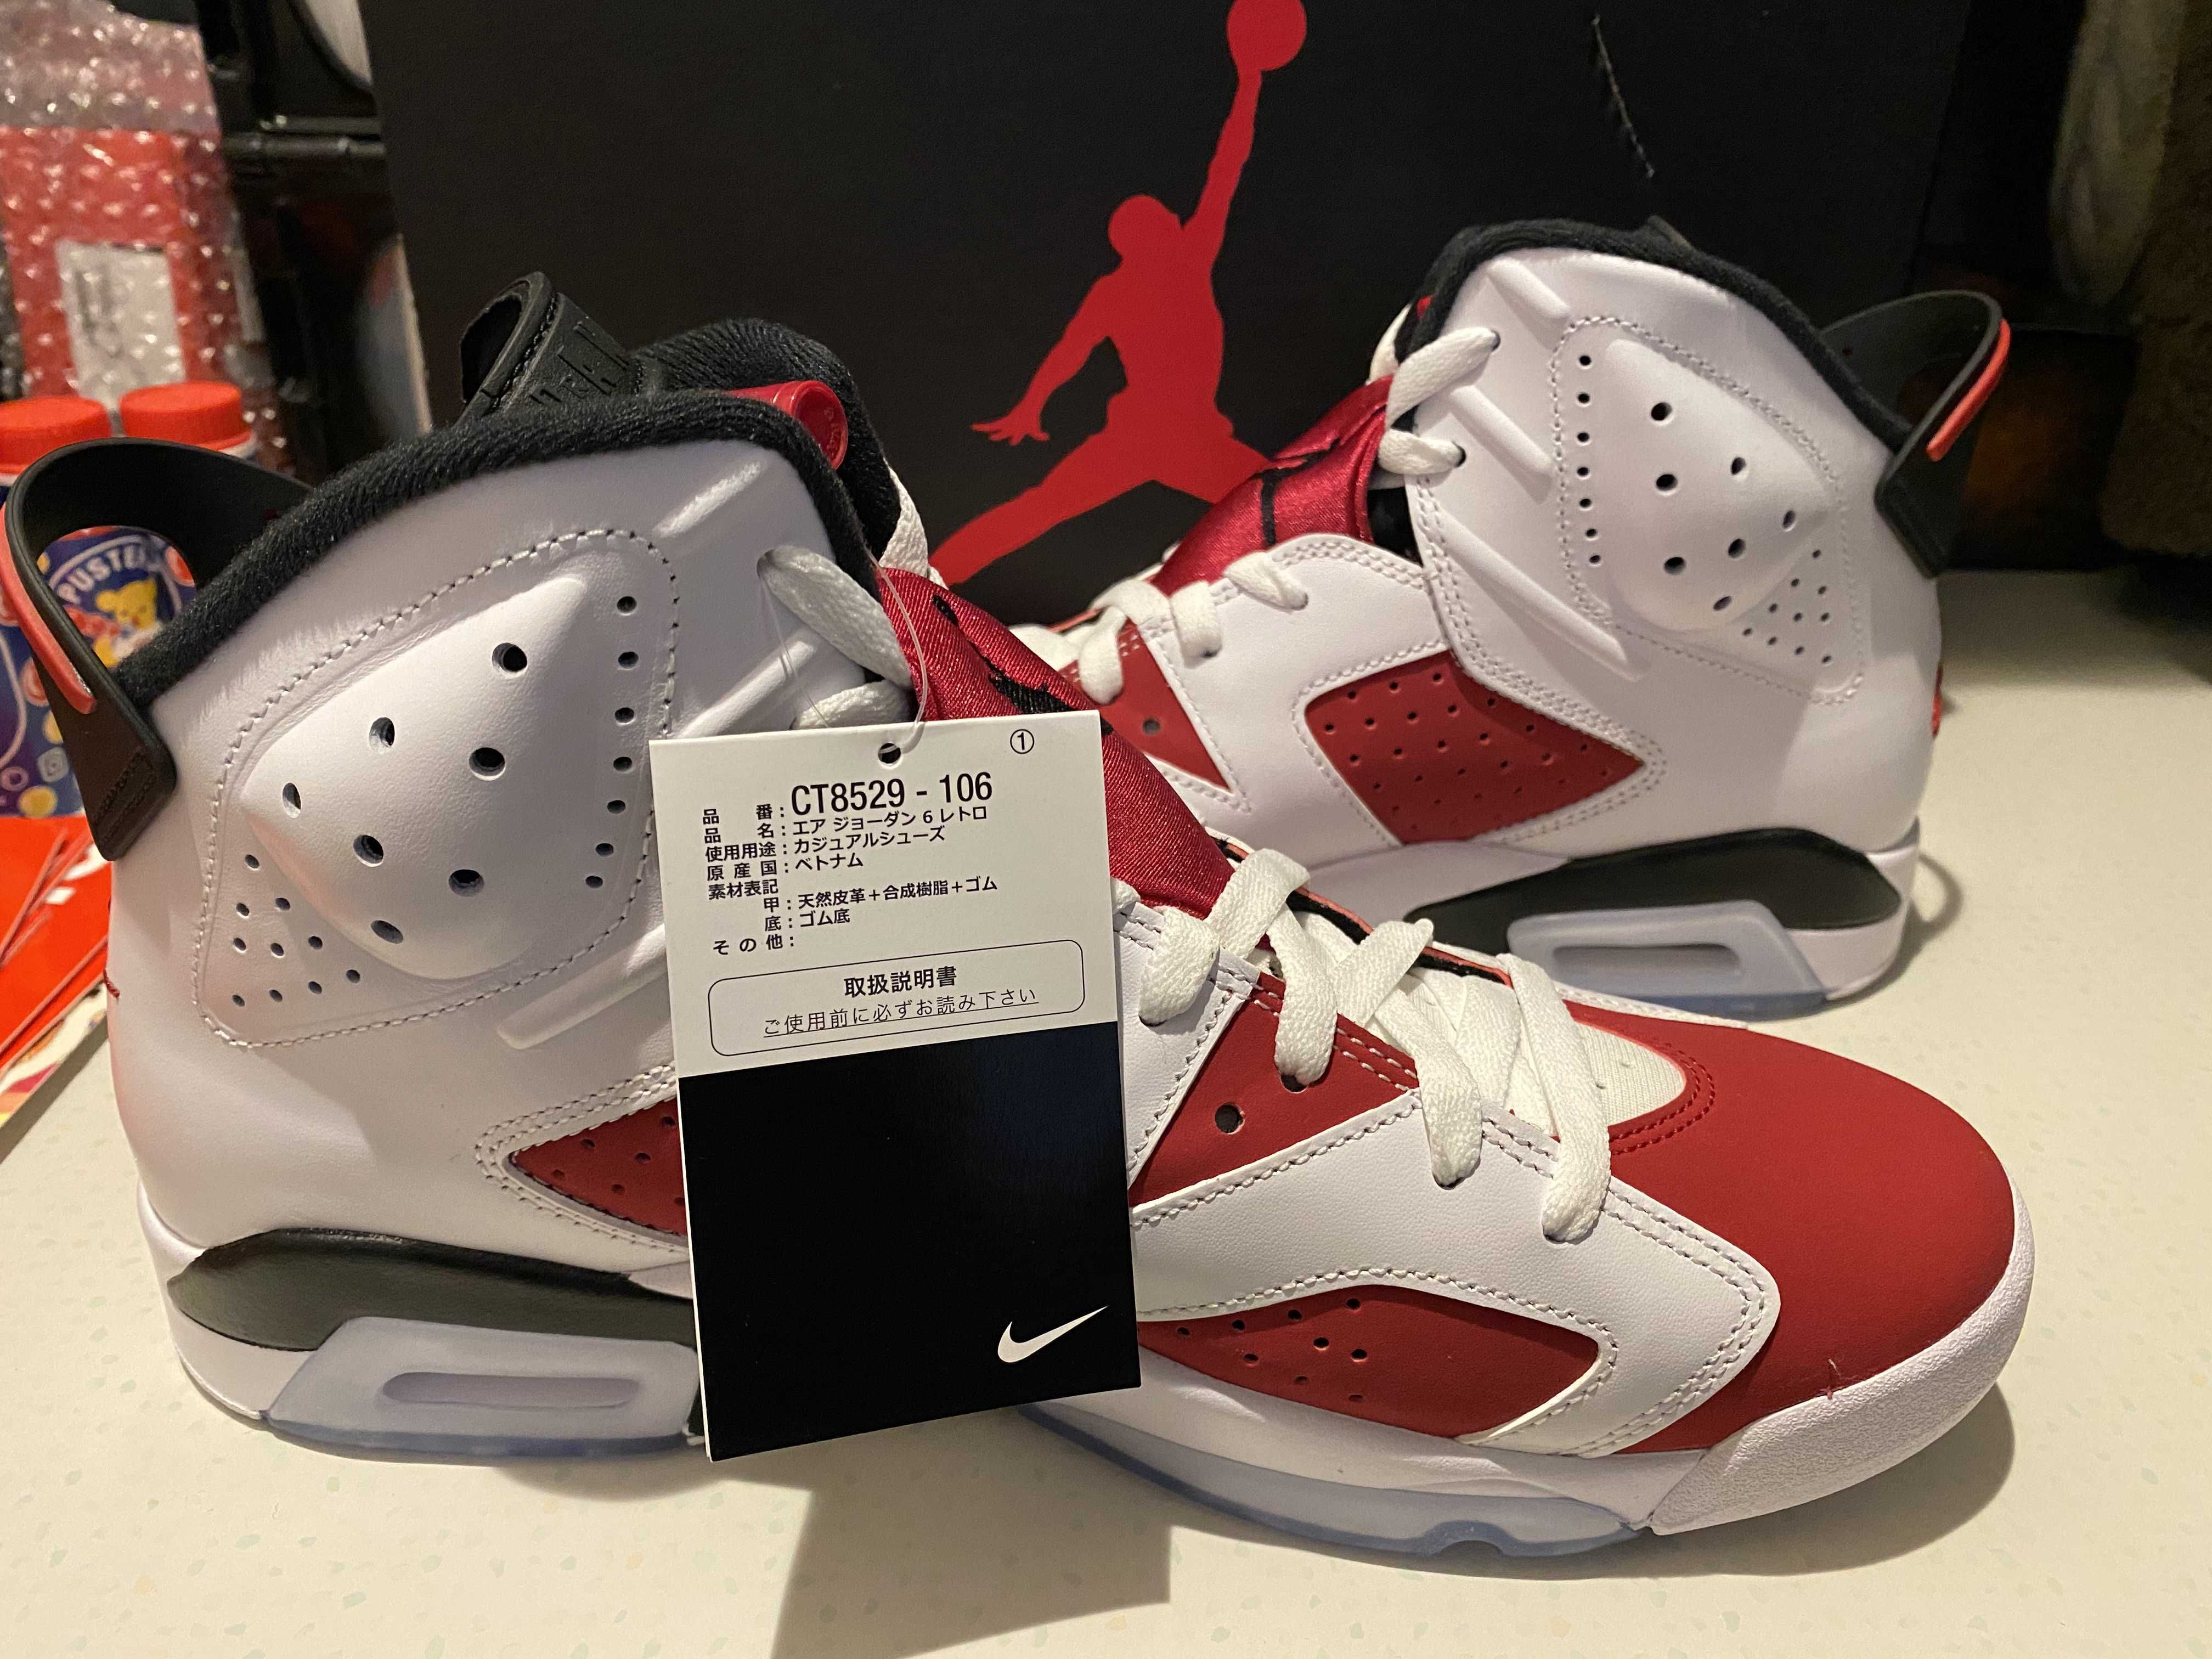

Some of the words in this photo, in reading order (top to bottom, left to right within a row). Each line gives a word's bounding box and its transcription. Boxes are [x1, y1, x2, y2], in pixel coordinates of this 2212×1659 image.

[791, 778, 905, 815] CT8529
[939, 772, 992, 803] 106
[922, 810, 933, 824] 6
[940, 806, 987, 822] レトロ
[794, 825, 945, 854] カジュアルシューズ
[795, 853, 864, 871] ベトナム
[708, 879, 778, 900] 素材表記
[800, 909, 850, 928] ゴム底
[843, 966, 958, 998] 取扱説明書
[764, 988, 1036, 1035] ご使用前に必ずお読み下さい
